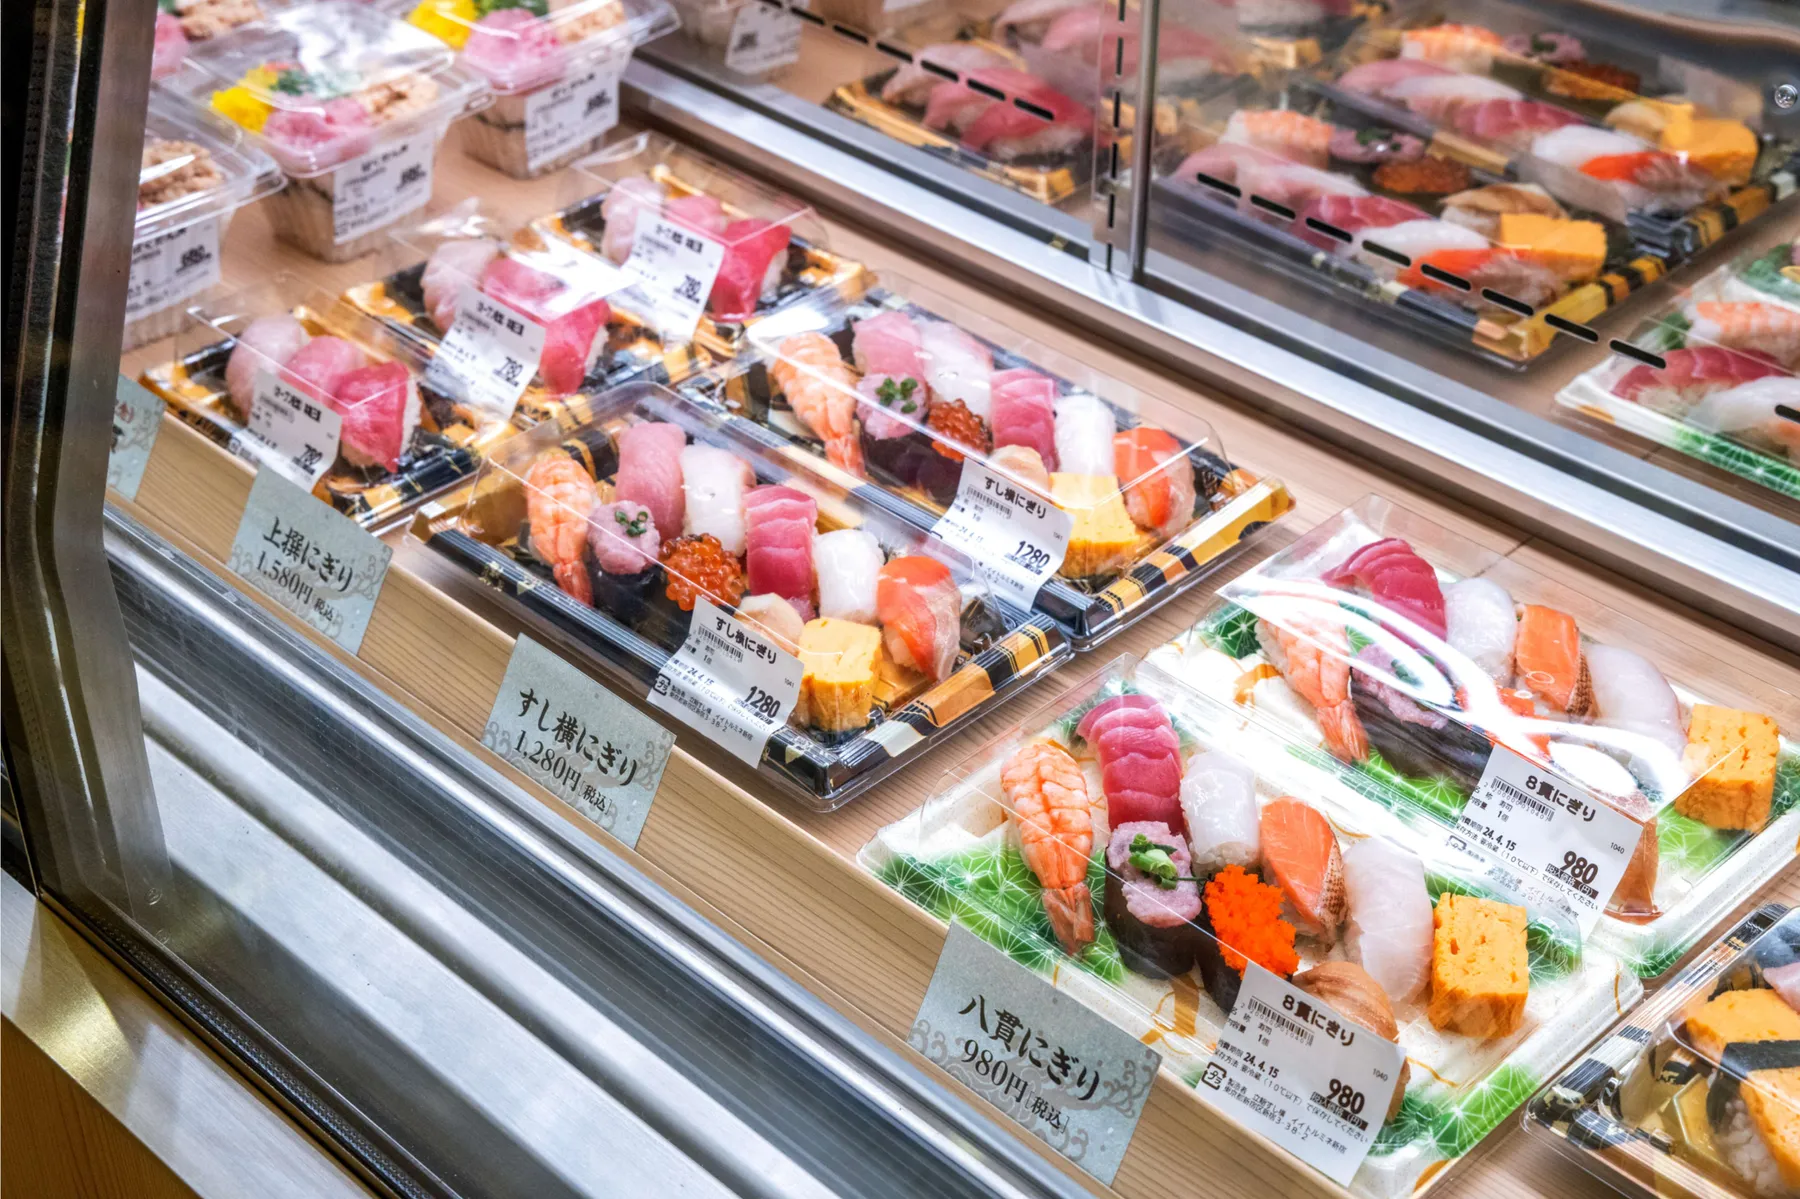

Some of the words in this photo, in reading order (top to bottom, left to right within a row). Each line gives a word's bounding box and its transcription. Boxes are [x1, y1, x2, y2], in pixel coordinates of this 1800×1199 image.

[984, 476, 1046, 519] すし横にぎり
[1014, 540, 1050, 569] 1280
[716, 616, 777, 664] すし横にぎり
[744, 685, 781, 718] 1280
[518, 688, 637, 786] すし横にぎり
[1610, 842, 1625, 854] 1040
[1560, 850, 1598, 885] 980
[1258, 1022, 1272, 1035] 寿司
[958, 994, 1100, 1101] 八貫にぎり
[1372, 1068, 1388, 1082] 1040
[1326, 1078, 1365, 1115] 980
